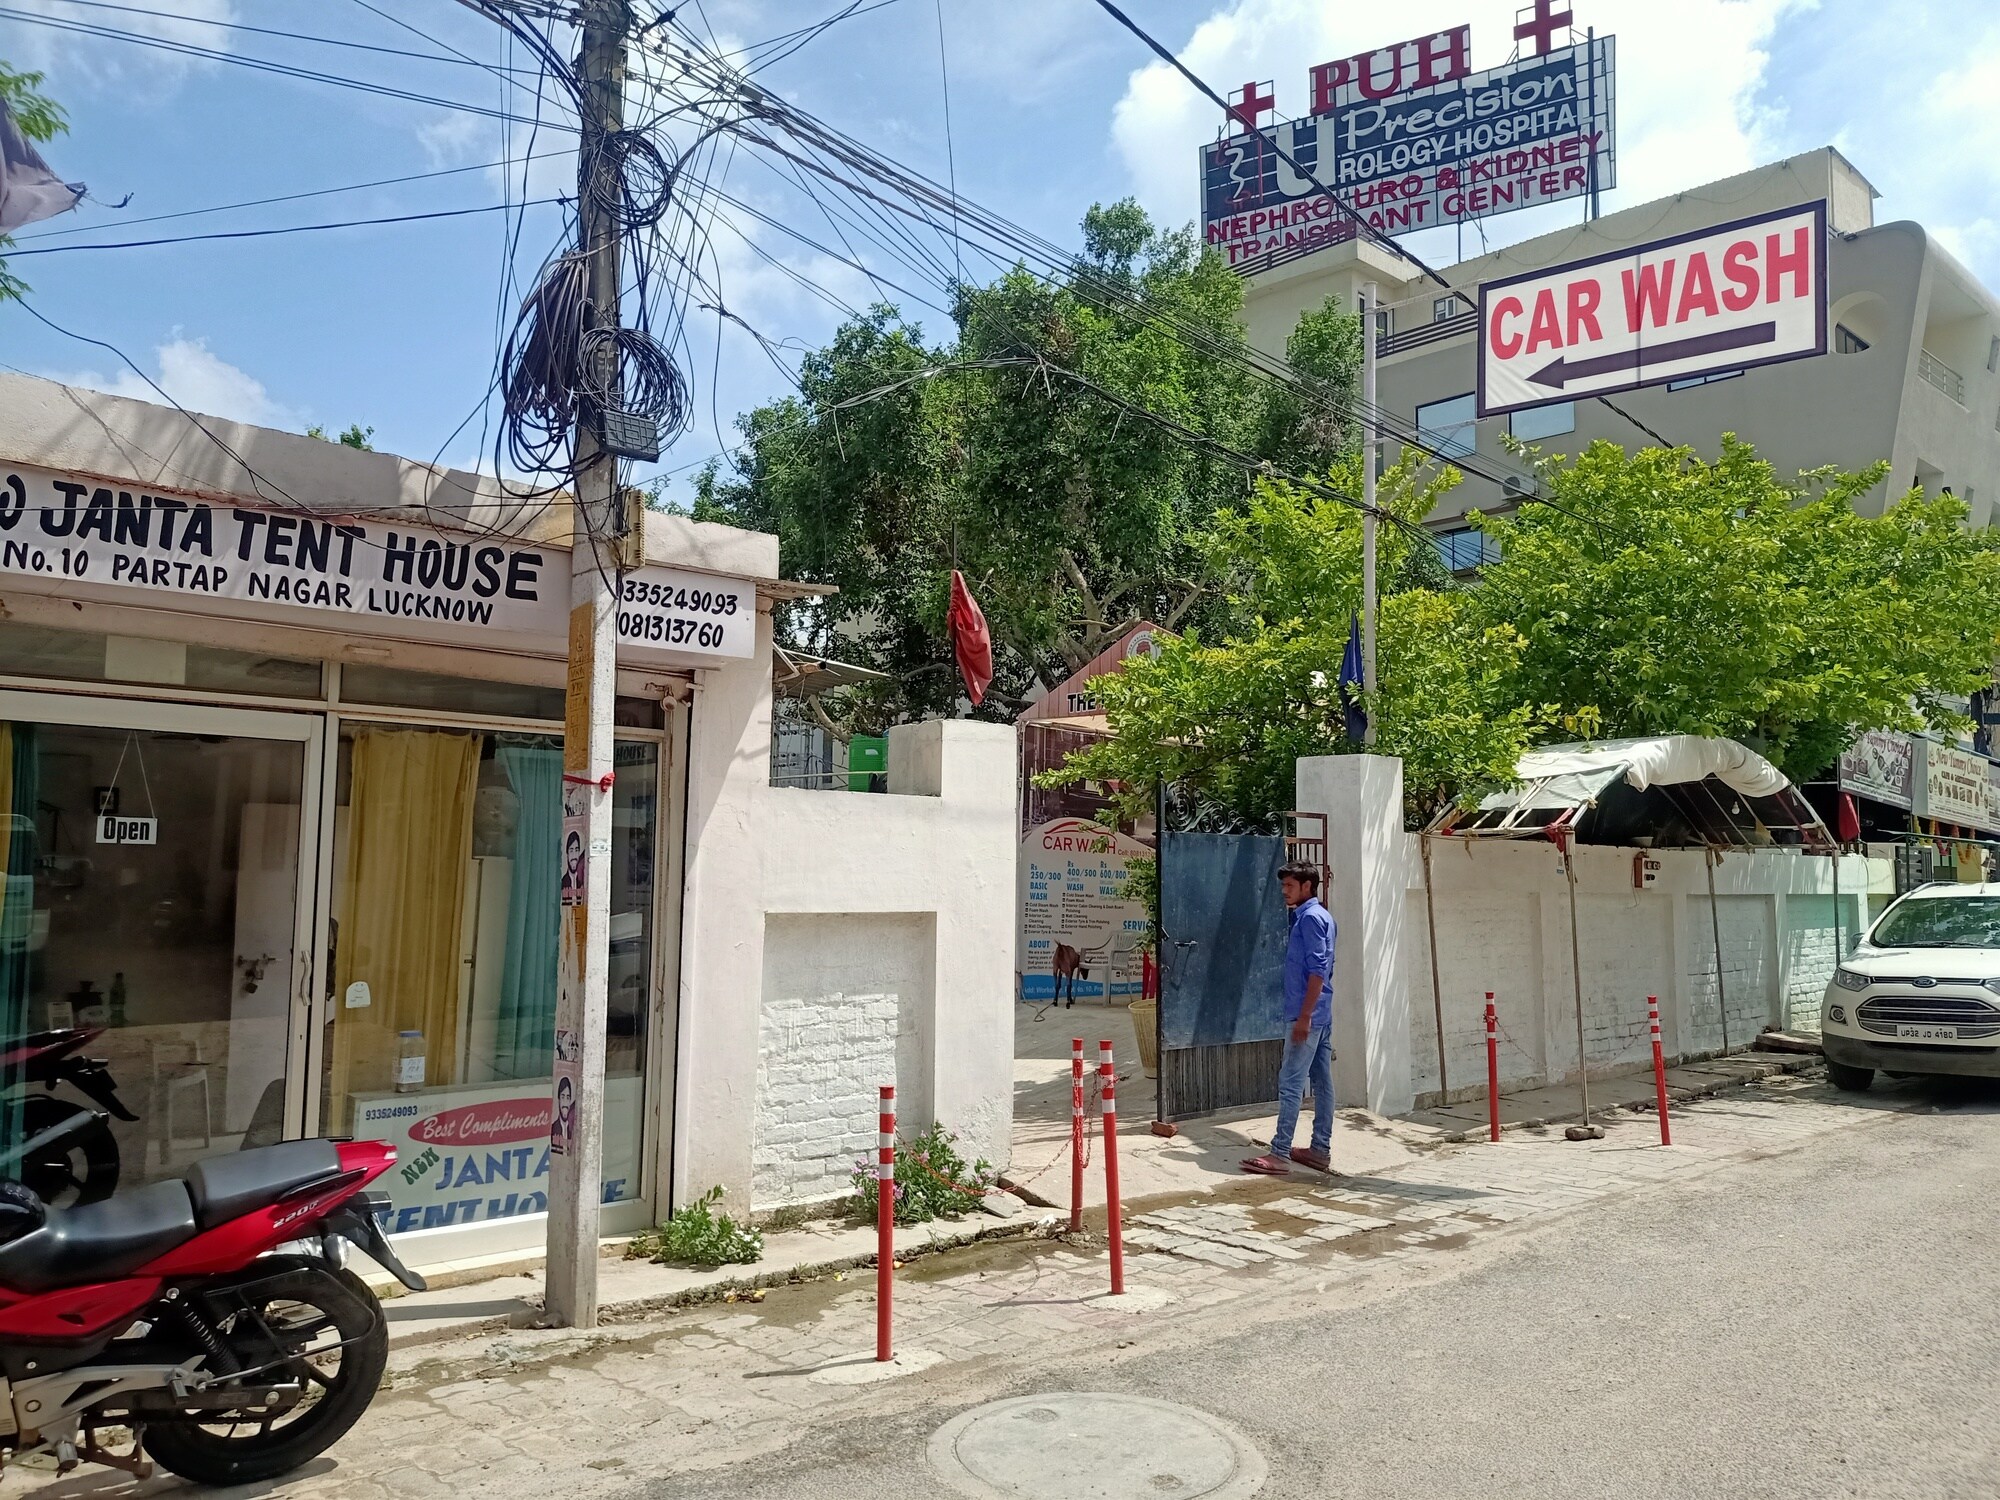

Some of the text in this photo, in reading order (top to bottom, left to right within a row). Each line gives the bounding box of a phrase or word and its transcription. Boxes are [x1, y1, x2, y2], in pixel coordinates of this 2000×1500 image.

[1311, 26, 1471, 114] PUH
[1341, 70, 1574, 151] Precision
[1338, 134, 1450, 185] ROLOGY
[1455, 100, 1593, 156] HOSPITAL
[1435, 167, 1460, 191] &
[1471, 130, 1603, 183] KIDNEY
[1443, 166, 1586, 216] CENTER
[1489, 226, 1809, 361] CAR WASH
[40, 480, 213, 557] JANTA
[233, 508, 366, 577] TENT
[382, 532, 544, 602] HOUSE
[112, 554, 228, 592] PARTAP
[249, 572, 353, 609] NAGAR
[368, 588, 494, 625] LUCKNOW
[621, 579, 738, 616] 335249093
[1066, 692, 1097, 713] THE
[103, 817, 150, 843] Open
[1043, 836, 1072, 851] CAR
[1030, 871, 1062, 881] 250/300
[1030, 882, 1048, 891] BASIC
[1067, 868, 1097, 877] 400/500
[1030, 892, 1048, 900] WASH
[1066, 883, 1084, 892] WASH
[1028, 940, 1051, 949] ABOUT
[1901, 1029, 1919, 1037] UP32
[365, 1105, 418, 1121] 9335249093
[423, 1109, 550, 1140] Best Compliments
[400, 1146, 441, 1186] NEW
[435, 1144, 550, 1191] JANTA
